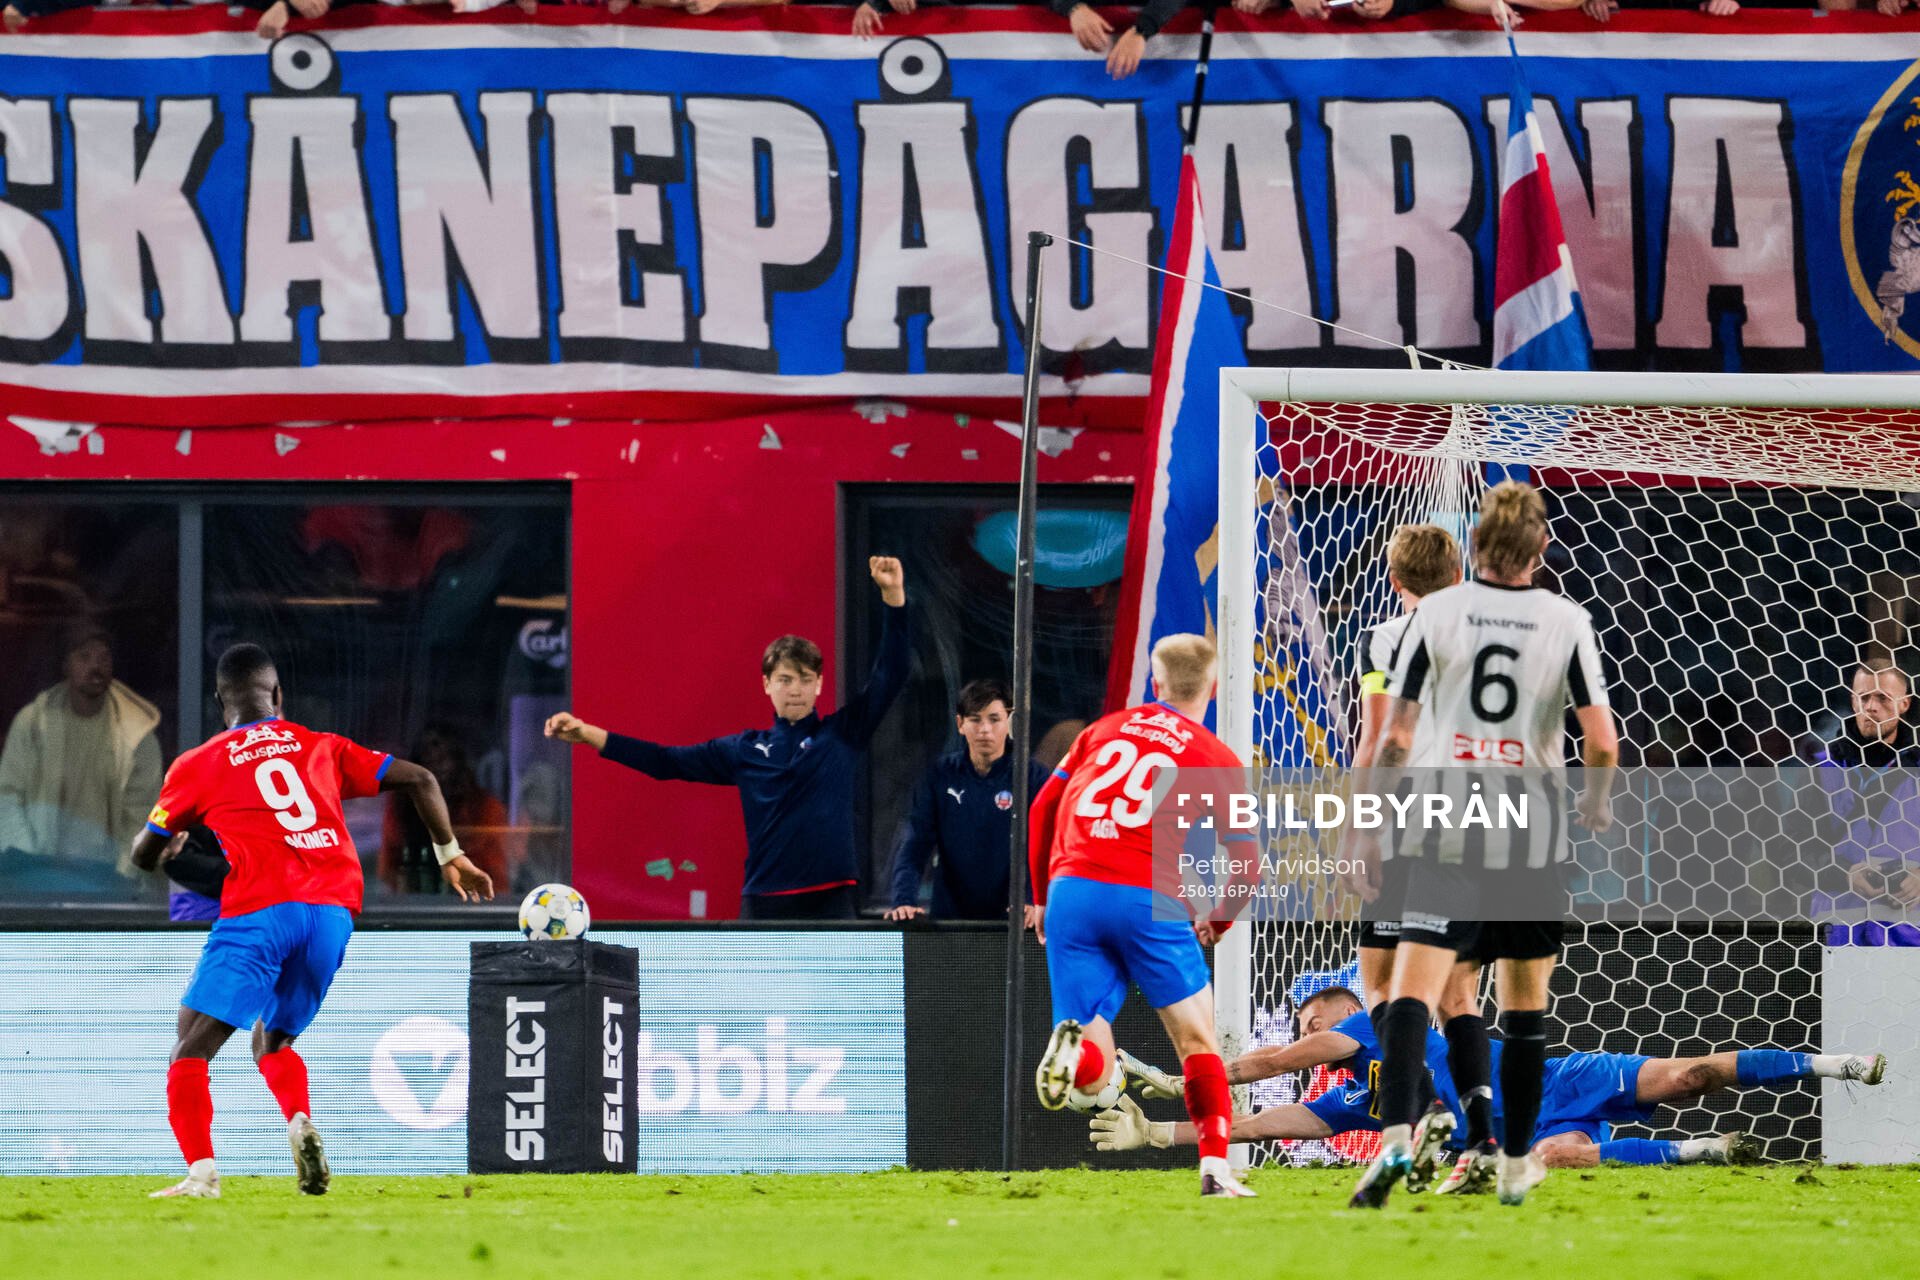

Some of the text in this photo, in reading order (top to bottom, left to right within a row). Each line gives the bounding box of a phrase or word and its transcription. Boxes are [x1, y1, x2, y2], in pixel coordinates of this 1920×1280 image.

[1470, 644, 1520, 724] 6
[254, 757, 317, 832] 9
[1075, 739, 1179, 828] 29
[1455, 738, 1523, 763] PULS
[505, 996, 546, 1161] SELECT
[602, 996, 623, 1163] SELECT
[637, 1017, 847, 1114] bbiz
